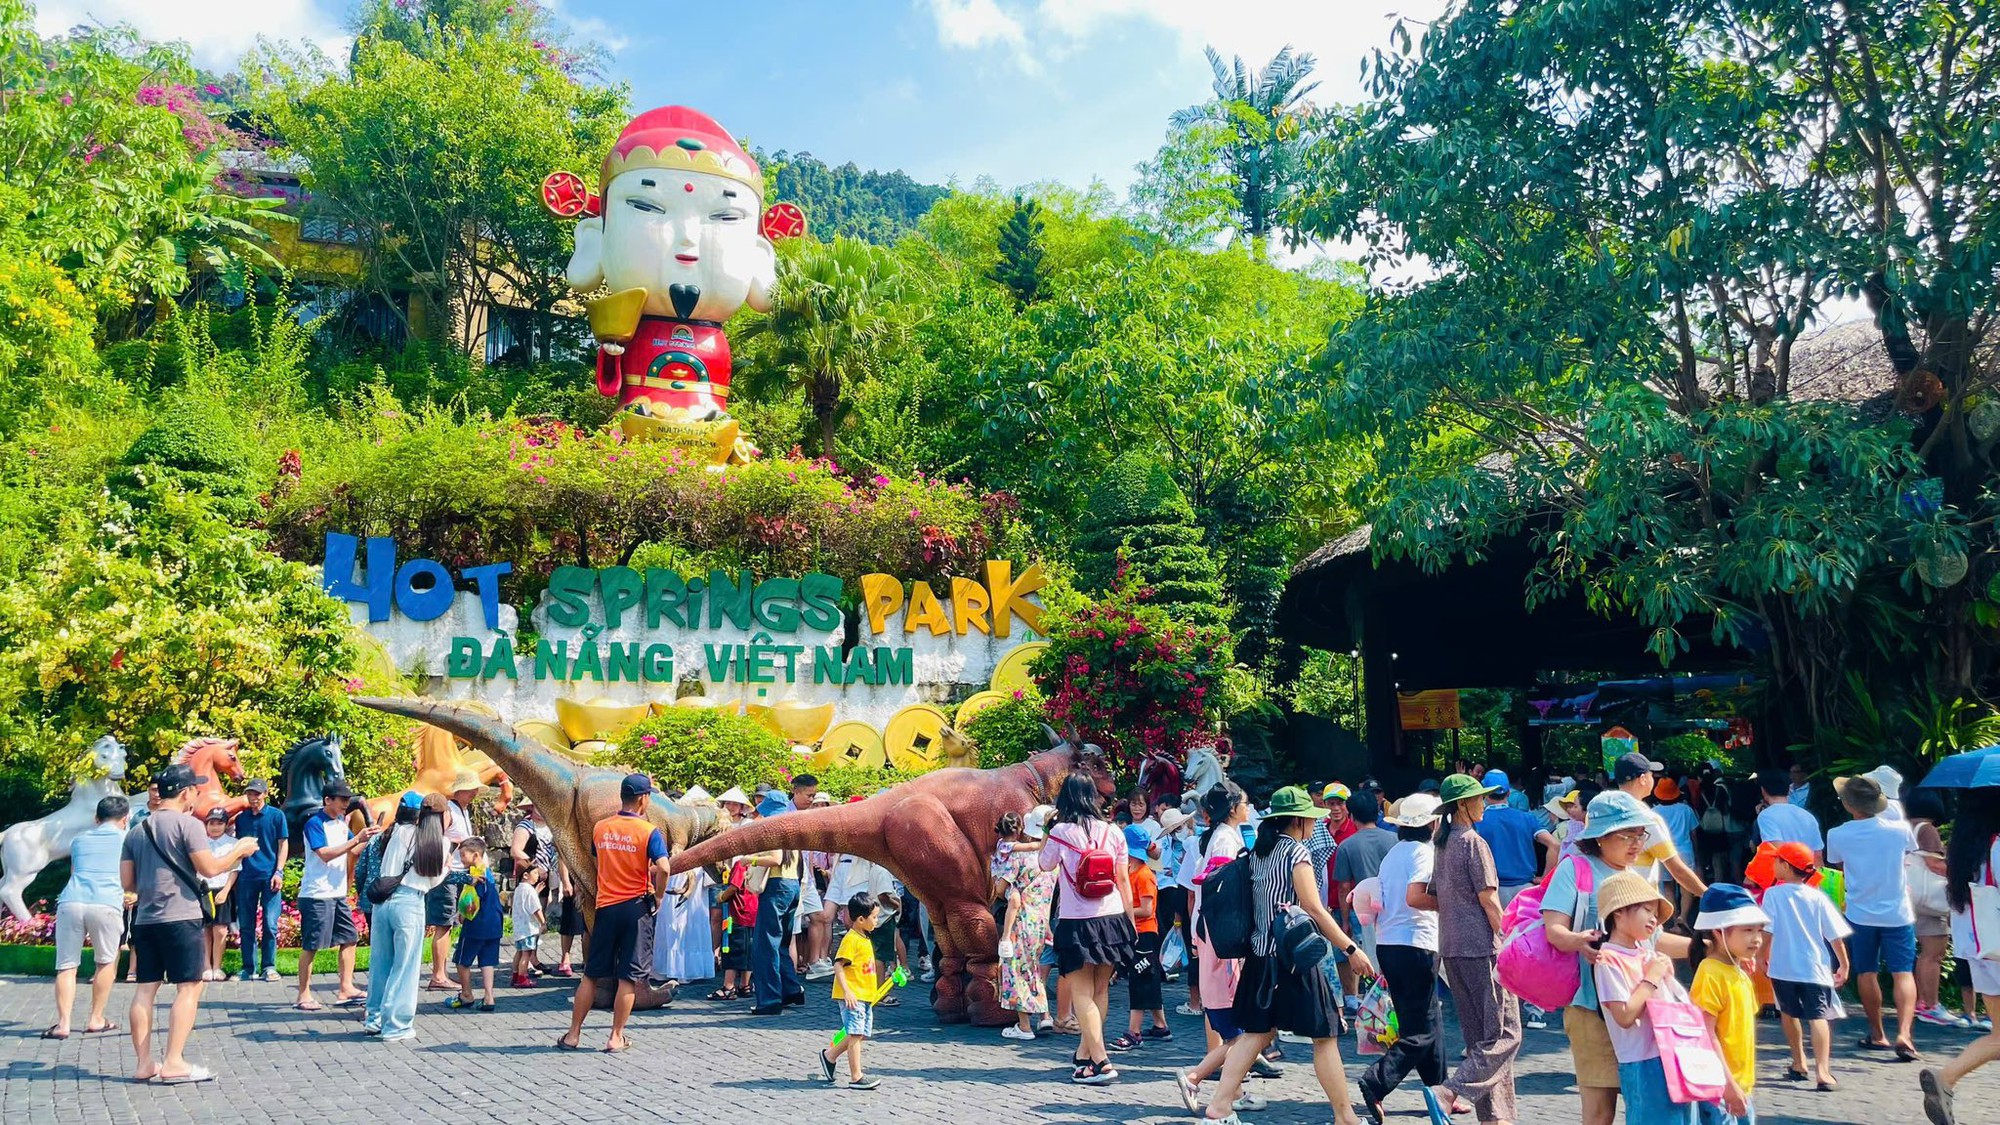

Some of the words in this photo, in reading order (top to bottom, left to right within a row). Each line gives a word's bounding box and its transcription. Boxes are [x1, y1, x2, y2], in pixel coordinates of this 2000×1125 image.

[323, 531, 512, 631] HOT
[860, 560, 1049, 638] PARK
[449, 628, 518, 680] ĐÀ
[704, 631, 804, 697] VIỆT
[814, 647, 914, 685] NAM
[598, 842, 637, 853] LIFEGUARD
